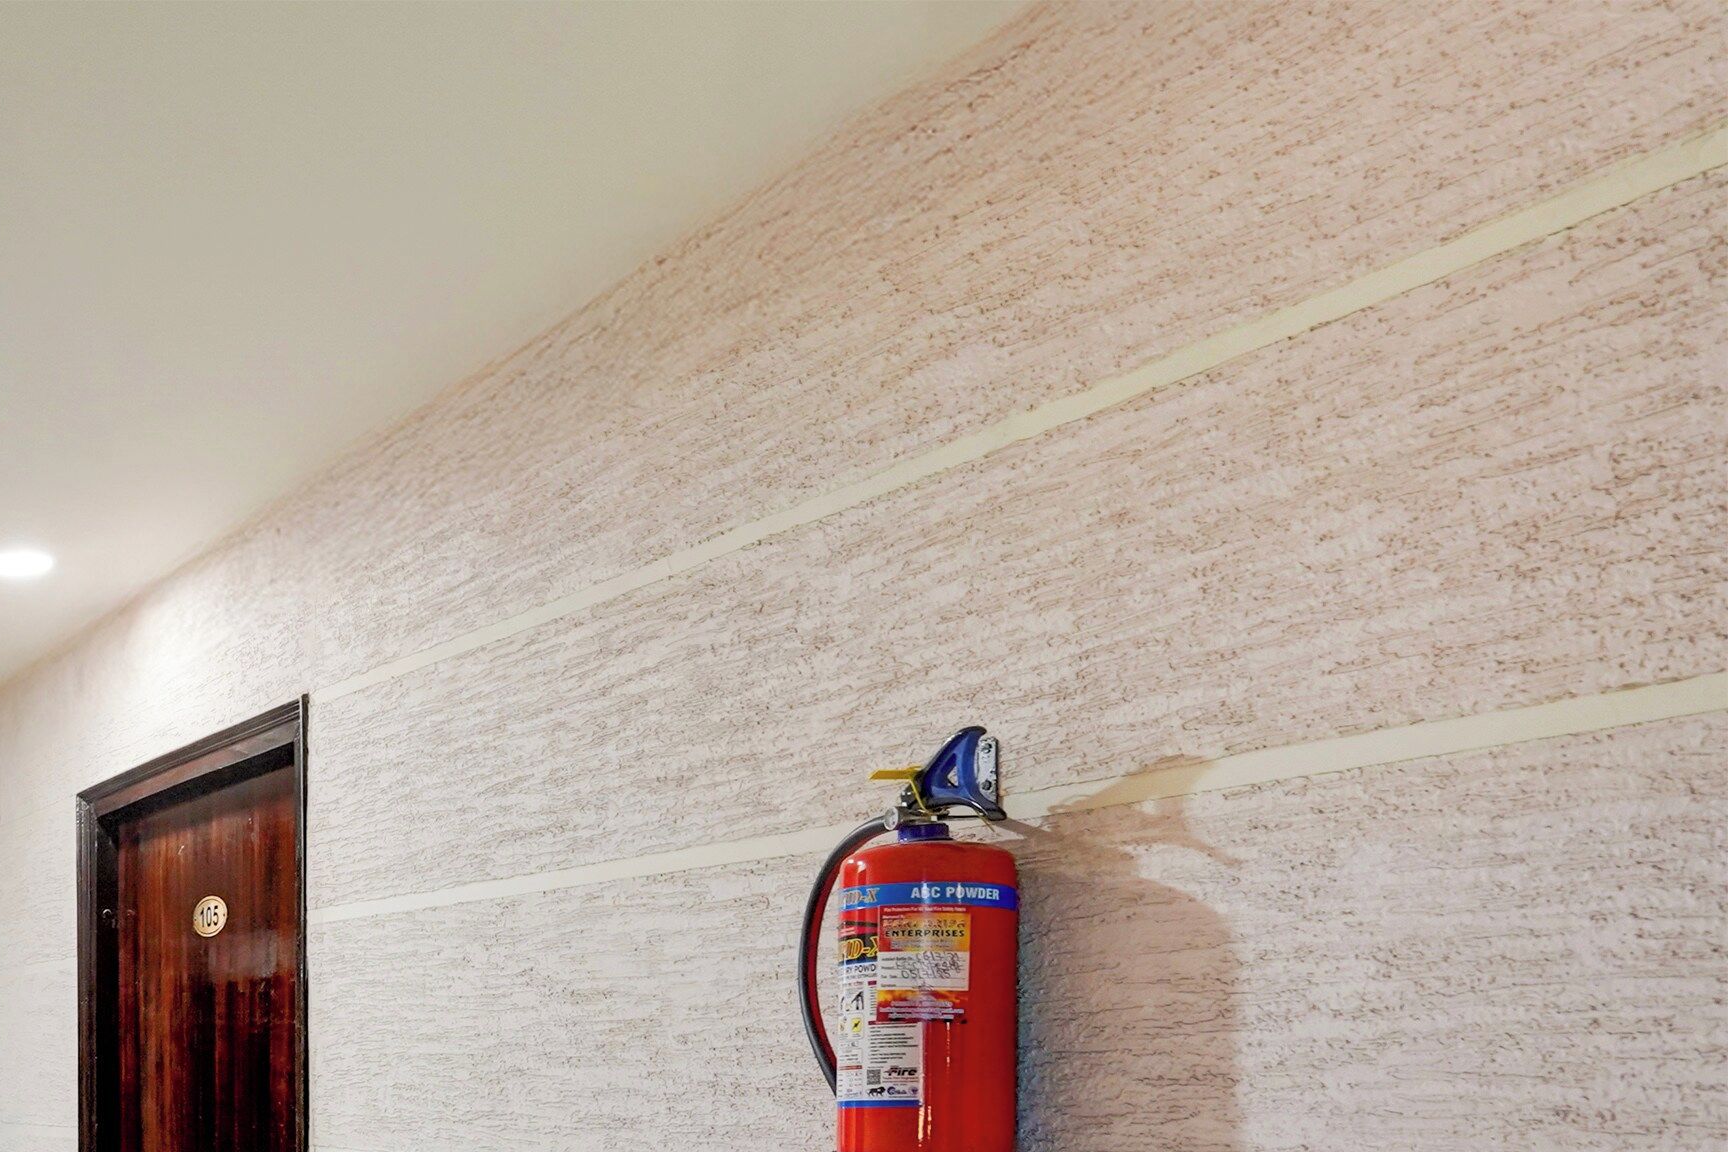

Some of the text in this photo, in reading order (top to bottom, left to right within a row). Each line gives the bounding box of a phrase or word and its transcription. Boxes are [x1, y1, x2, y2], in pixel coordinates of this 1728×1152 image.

[911, 886, 1000, 900] ABC POWDER
[200, 905, 219, 927] 105
[885, 928, 966, 938] ENTERPRISES
